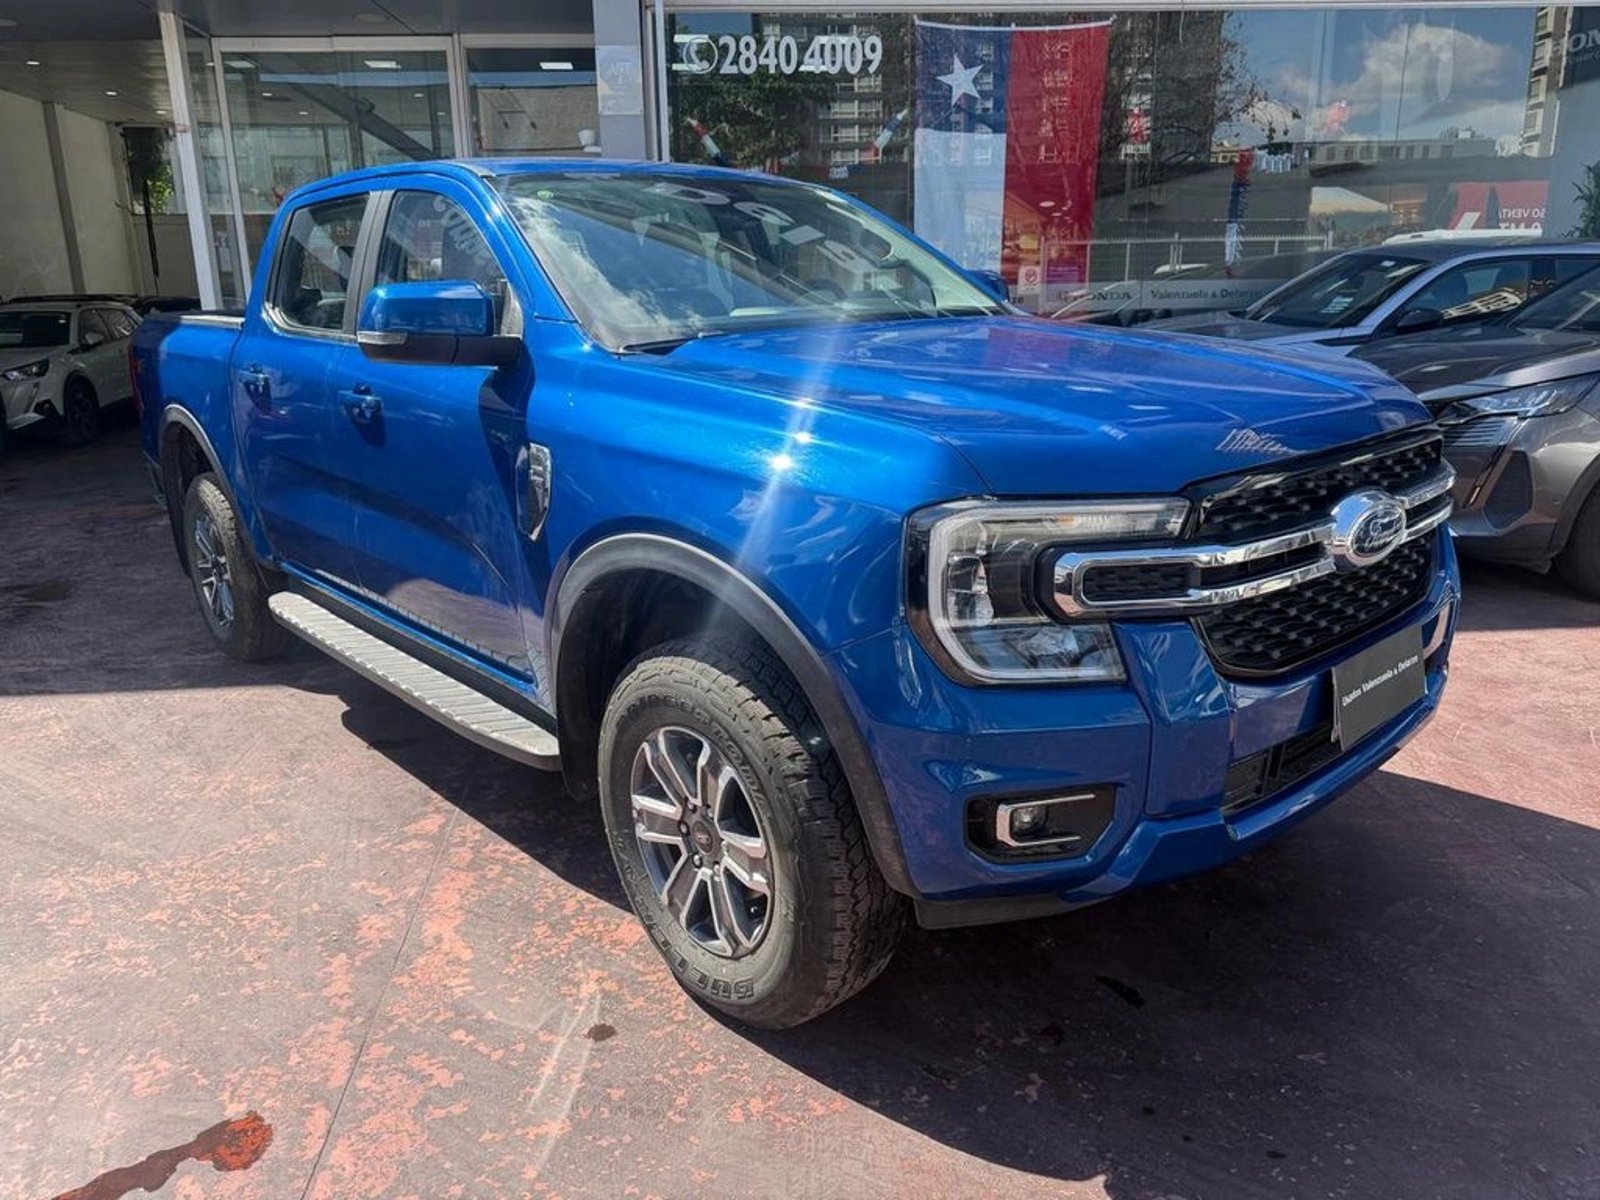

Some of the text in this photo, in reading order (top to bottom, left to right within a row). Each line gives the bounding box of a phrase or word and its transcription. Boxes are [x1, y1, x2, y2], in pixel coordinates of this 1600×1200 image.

[719, 35, 883, 74] 2840 4009
[1361, 669, 1394, 693] Valenzuela
